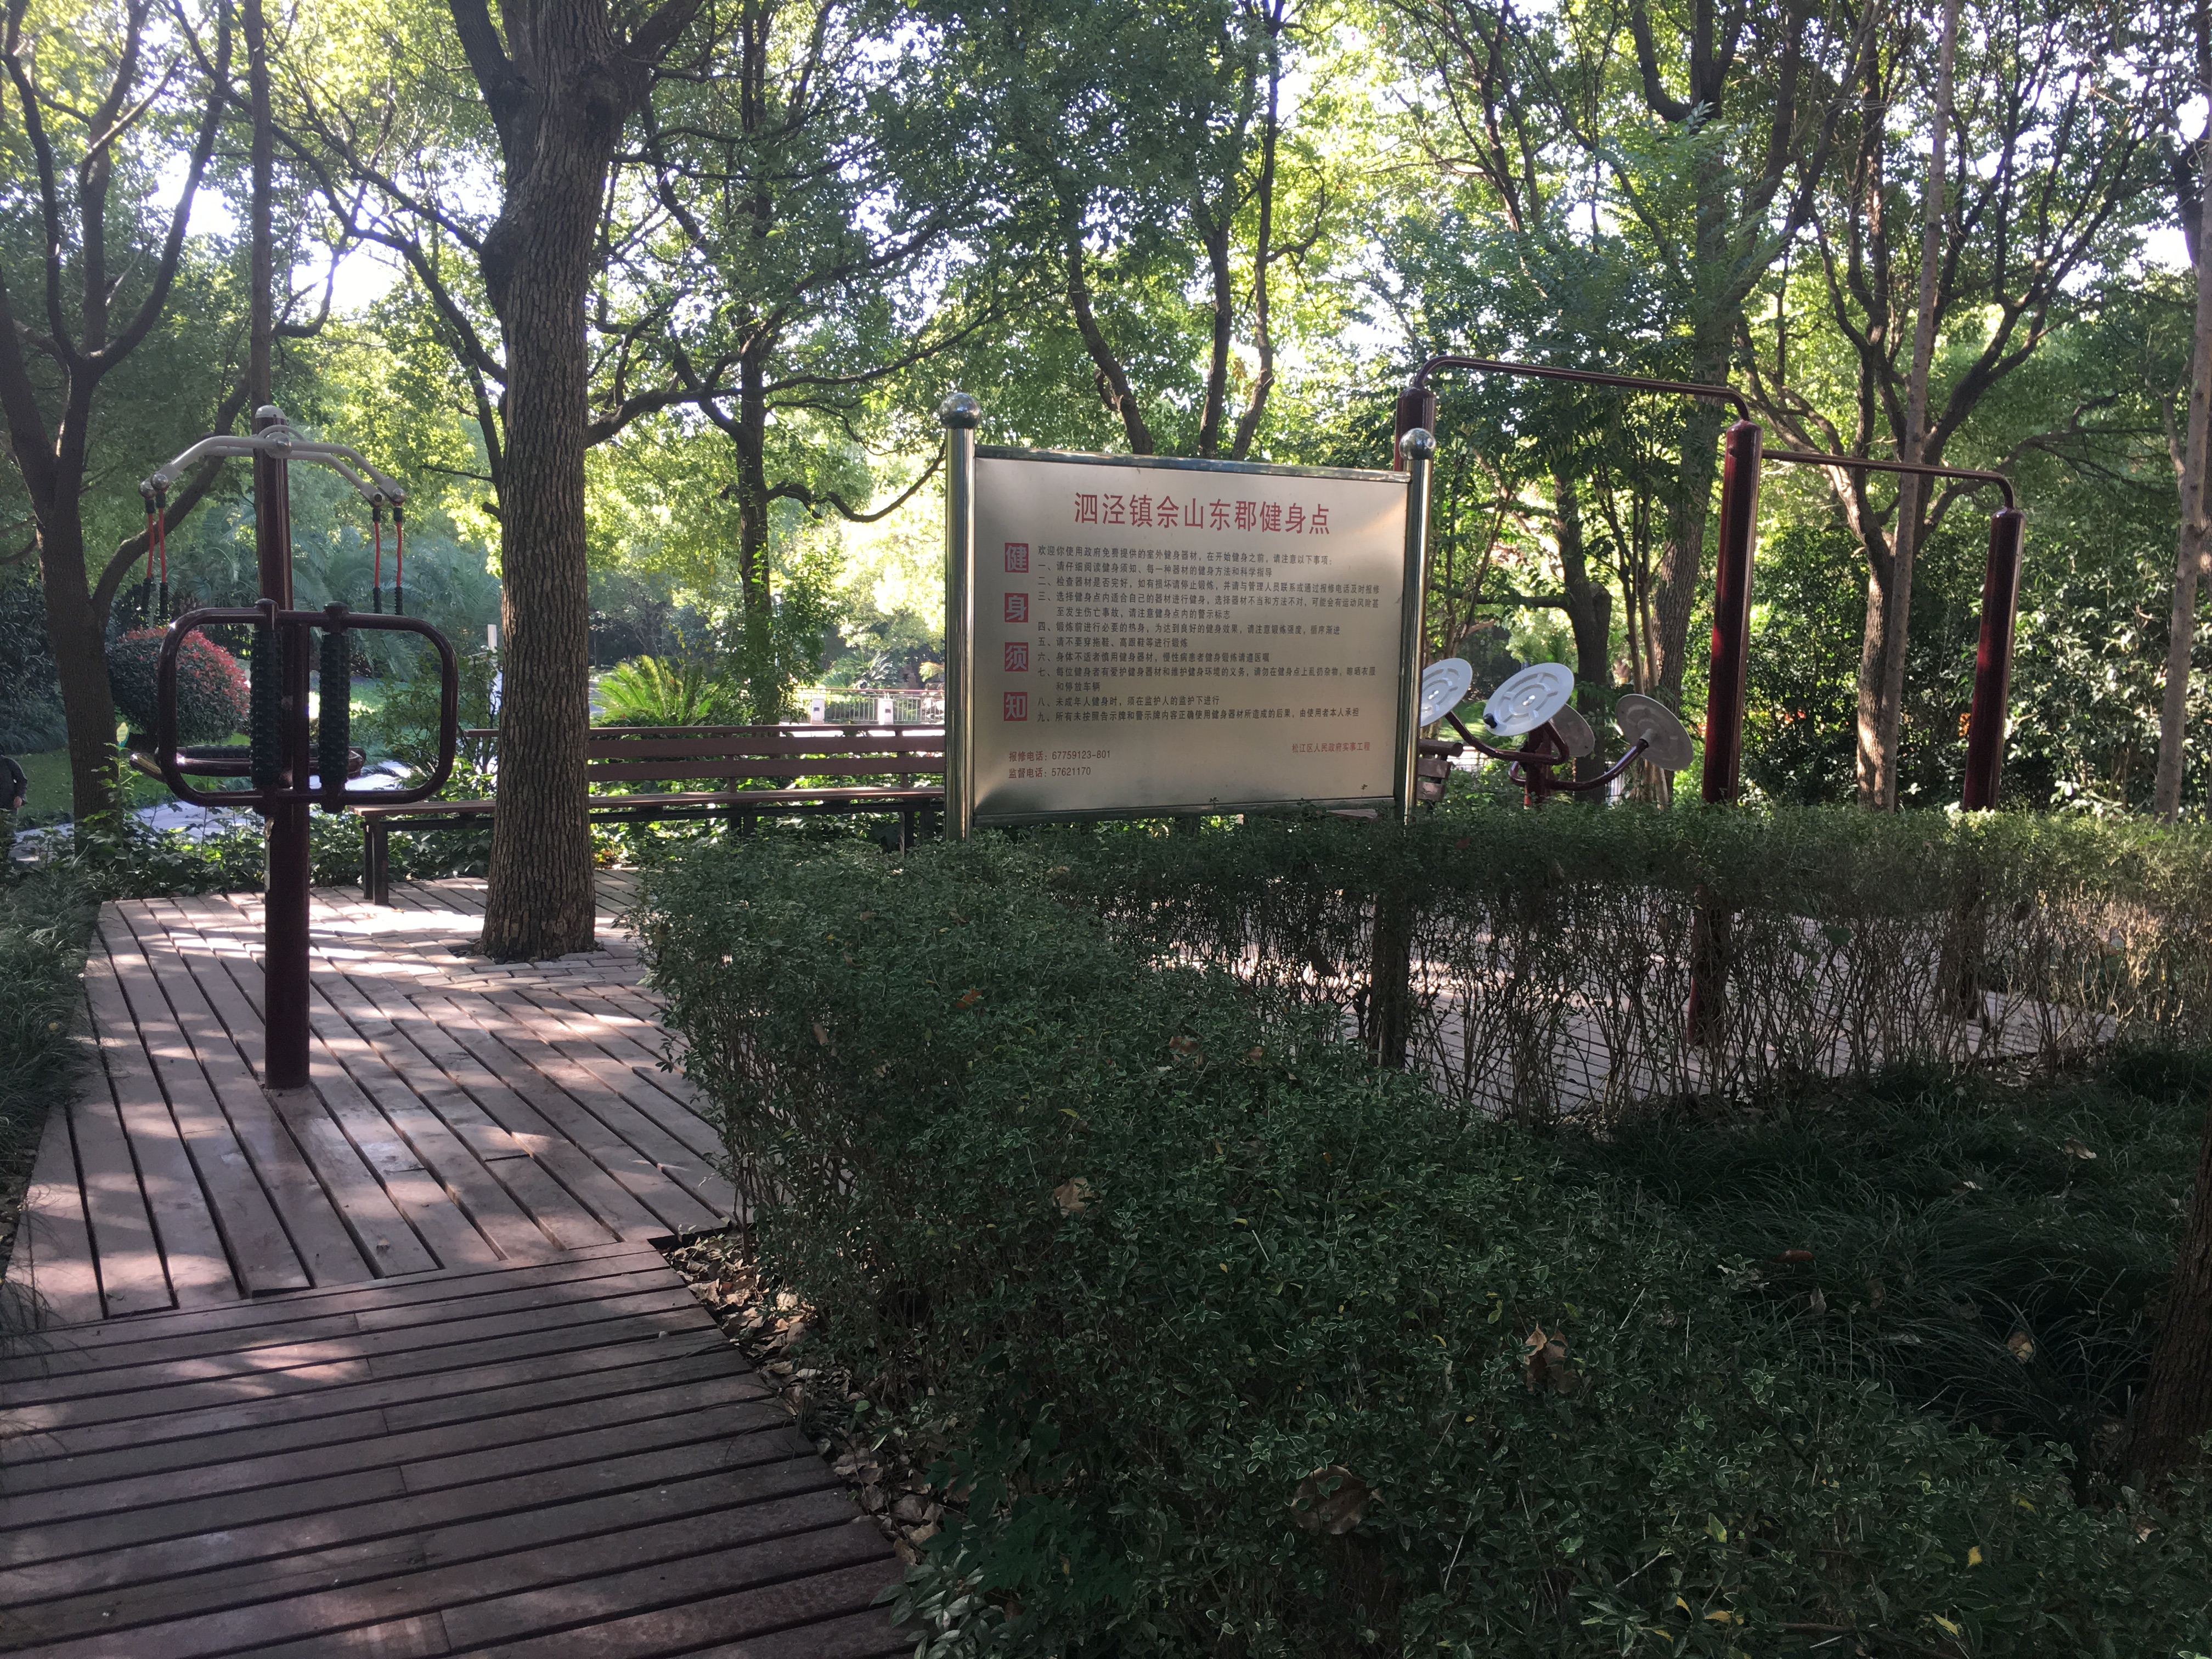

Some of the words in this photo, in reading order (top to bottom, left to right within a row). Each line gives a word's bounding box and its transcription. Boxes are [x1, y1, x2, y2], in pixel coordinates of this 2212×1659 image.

[1075, 493, 1329, 534] 泗泾镇佘山东郡健身点
[1056, 681, 1101, 692] 和停放车辆
[1292, 741, 1371, 754] 松江区人民政府实事工程
